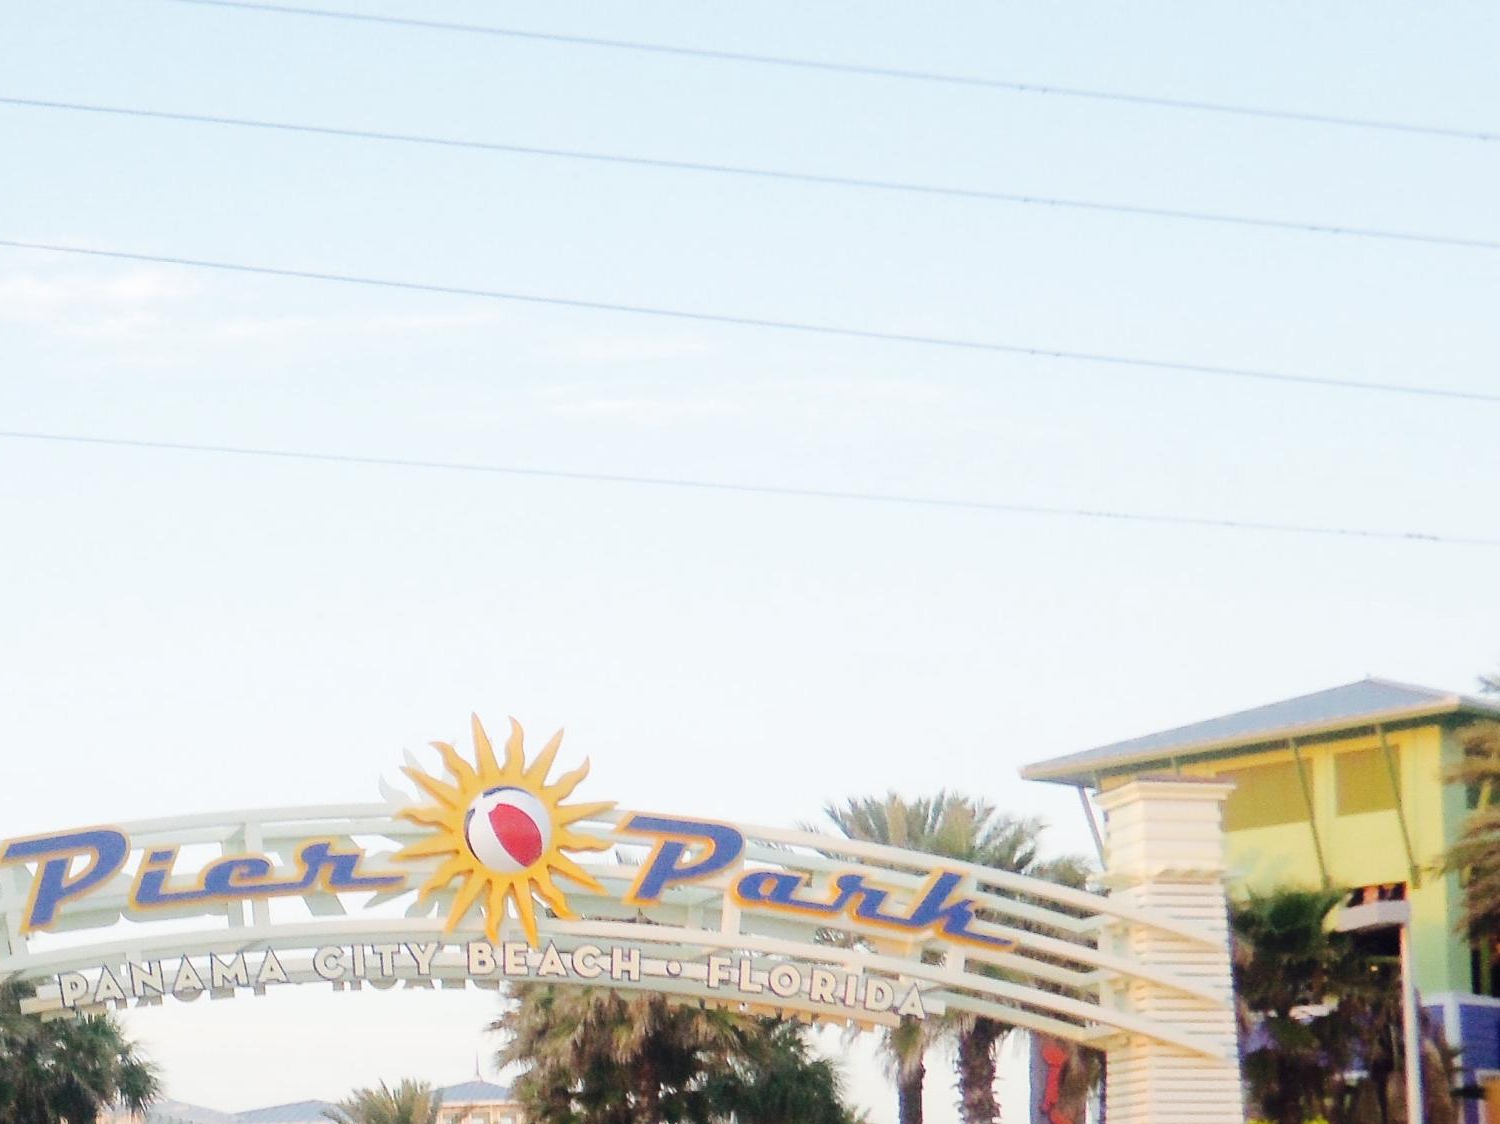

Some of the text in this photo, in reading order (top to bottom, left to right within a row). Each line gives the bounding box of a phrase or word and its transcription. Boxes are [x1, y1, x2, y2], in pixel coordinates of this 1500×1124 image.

[0, 809, 1019, 952] Pier Park
[57, 940, 927, 1020] PANAMA CITY BEACH FLORIDA
